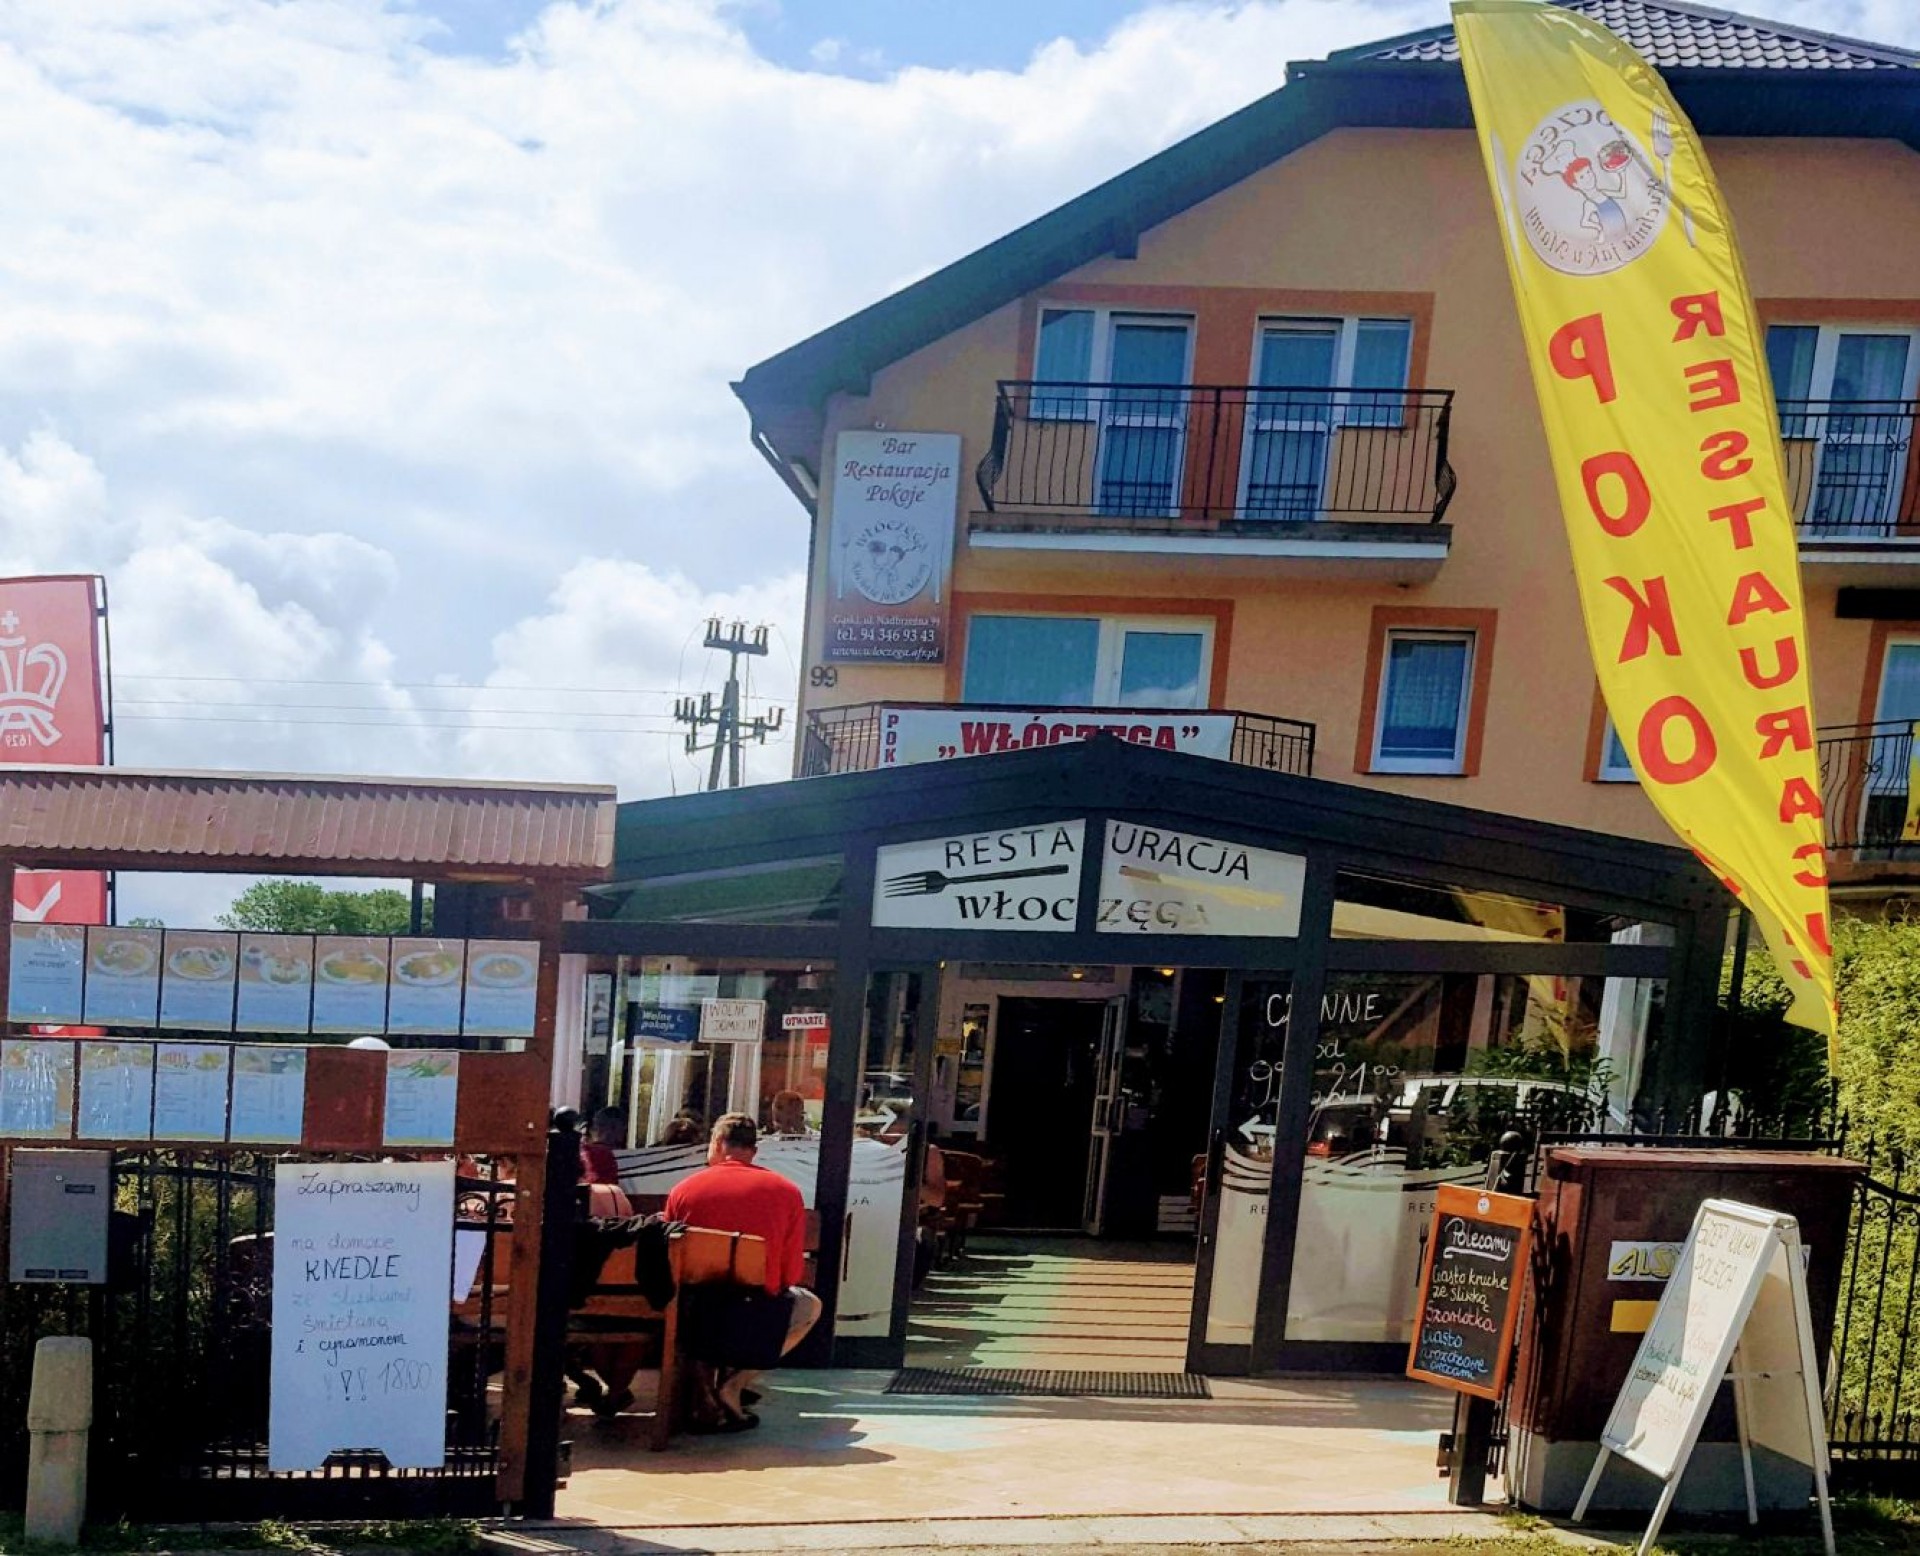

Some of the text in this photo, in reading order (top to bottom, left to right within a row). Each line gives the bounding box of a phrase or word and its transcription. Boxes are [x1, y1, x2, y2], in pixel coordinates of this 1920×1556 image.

[882, 437, 917, 455] Bar
[843, 460, 951, 486] Restauracja
[866, 482, 926, 510] Pokoje
[837, 628, 935, 642] tel. 94 346 93 43
[811, 666, 838, 688] 99
[297, 1172, 421, 1212] Zapraszamy
[291, 1236, 315, 1251] na
[1444, 1217, 1511, 1253] Polecamy
[305, 1254, 402, 1282] KNEDLE
[1469, 1268, 1508, 1290] kruche
[1432, 1285, 1448, 1298] ze
[294, 1333, 408, 1367] i cynamonem
